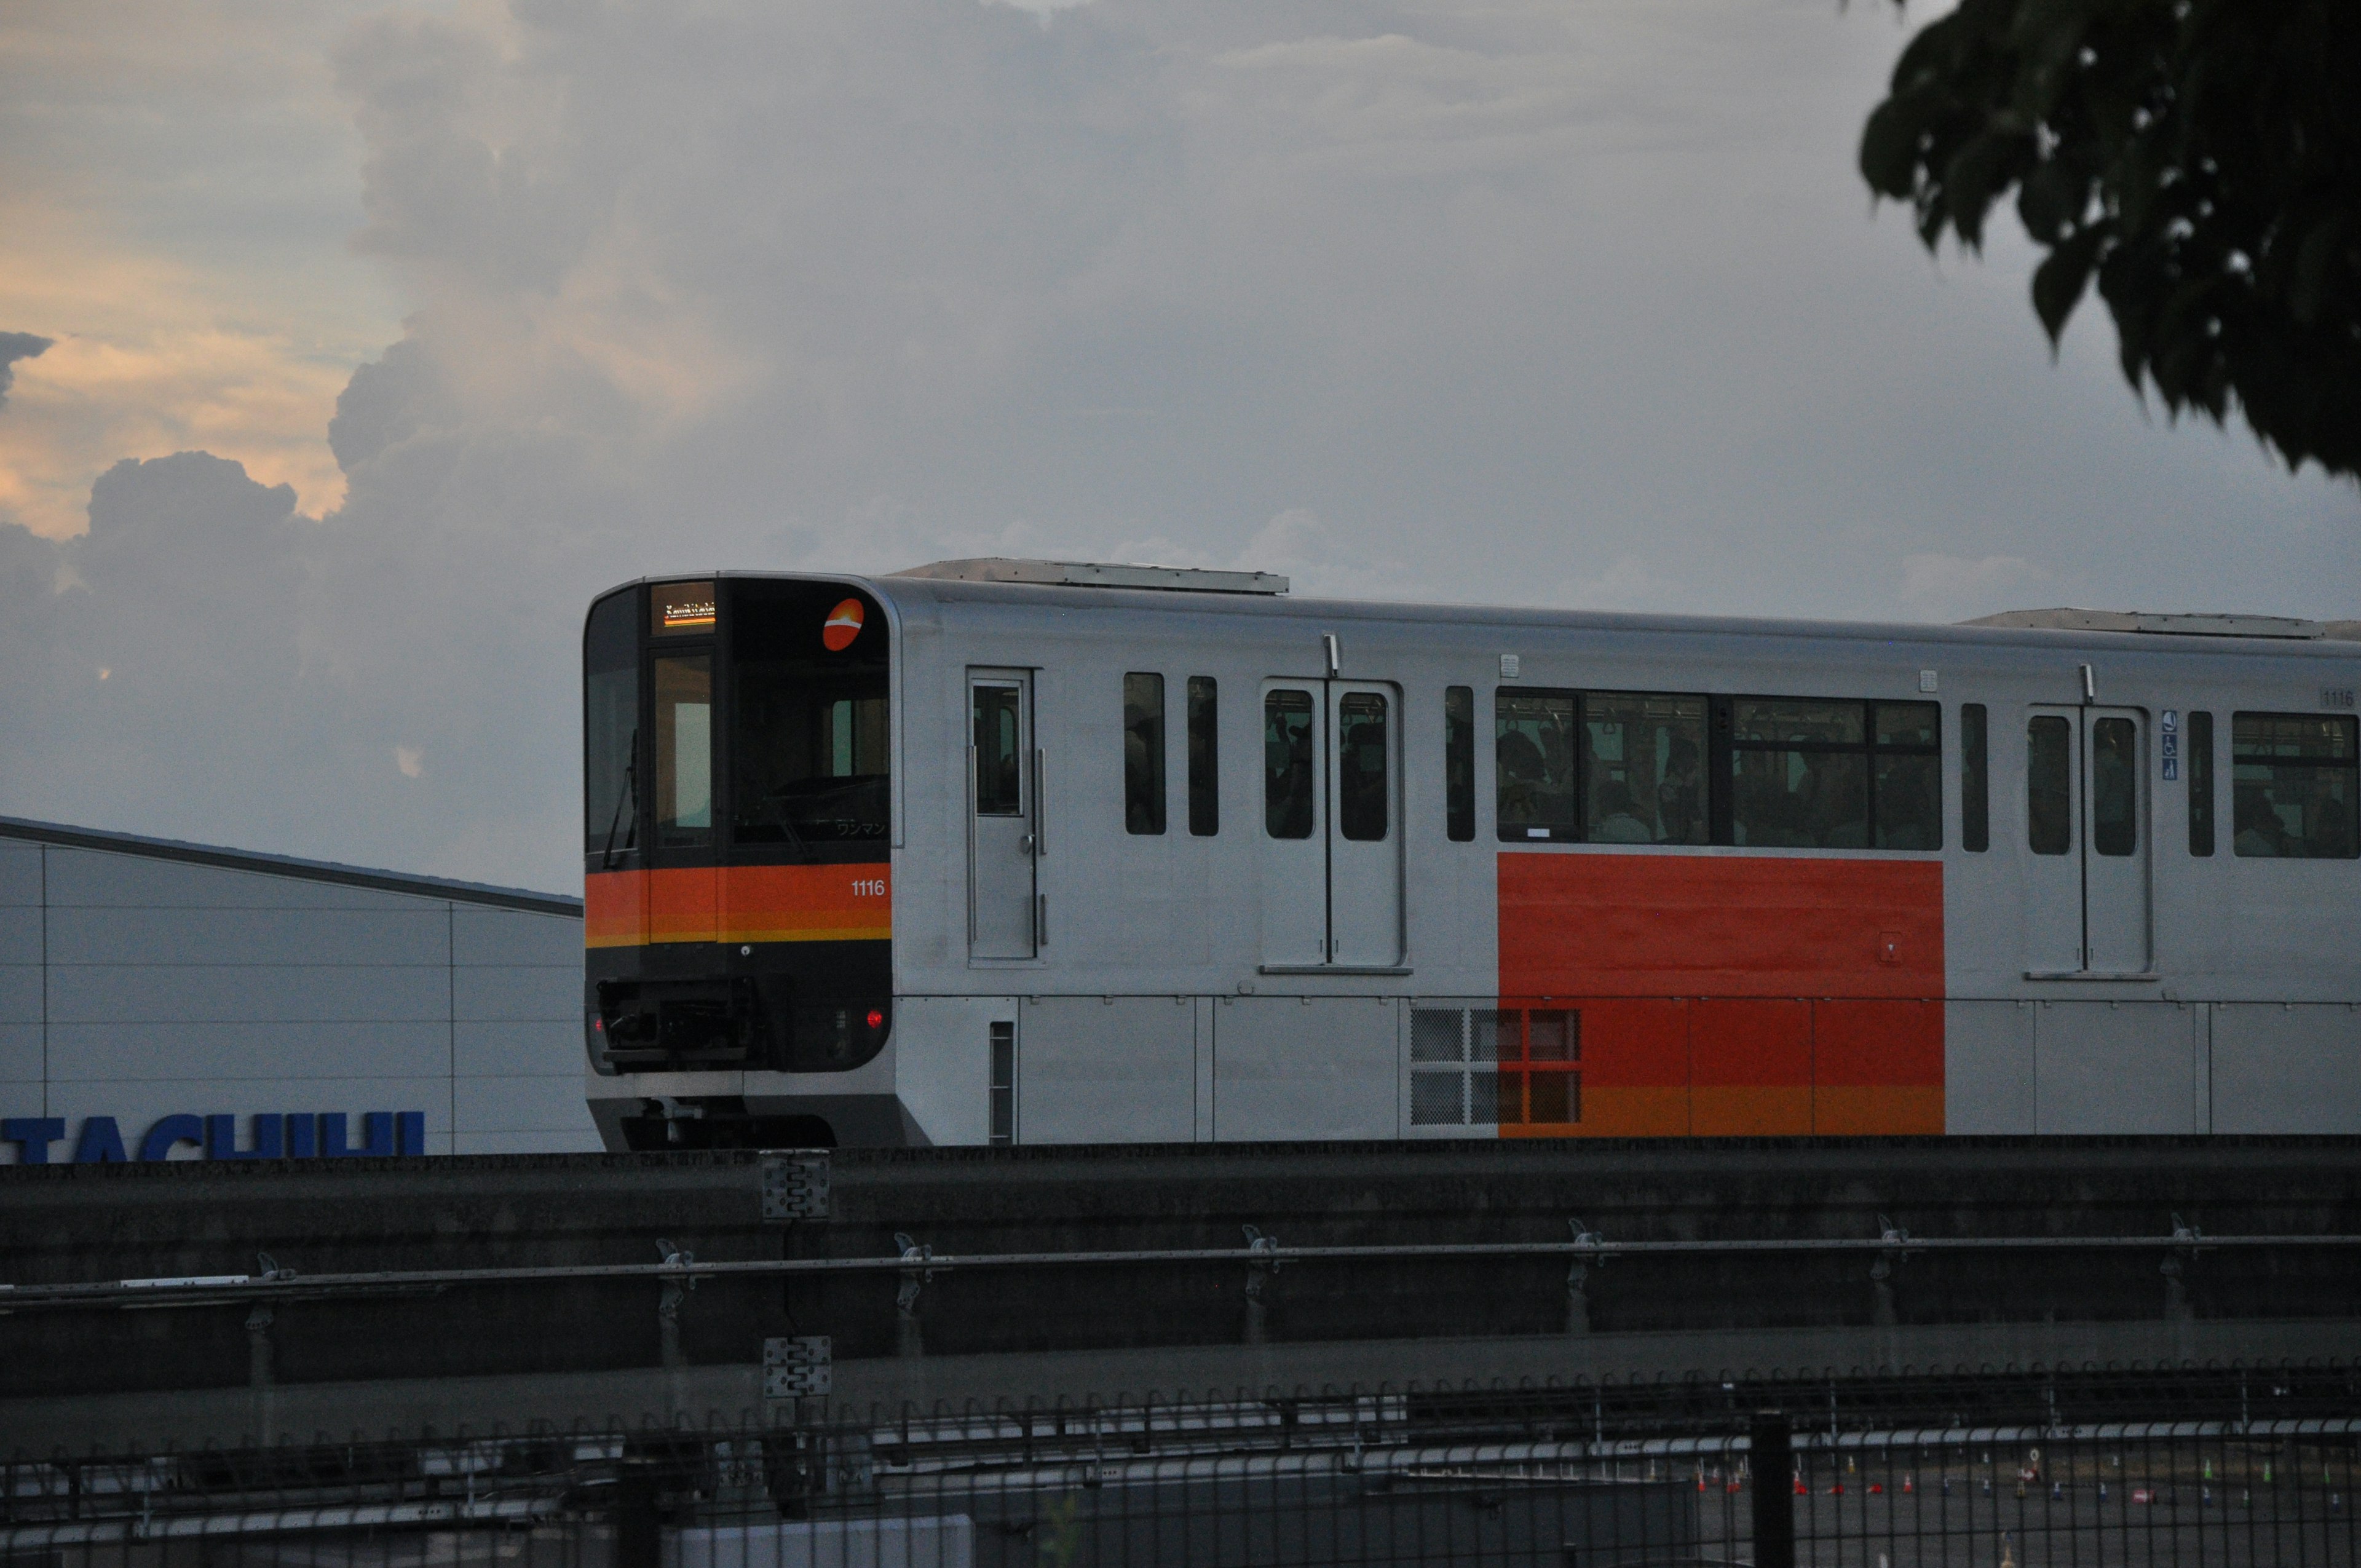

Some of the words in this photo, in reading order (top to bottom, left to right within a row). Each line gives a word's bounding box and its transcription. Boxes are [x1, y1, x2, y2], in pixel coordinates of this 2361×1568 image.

[2325, 691, 2354, 706] 1116
[837, 823, 885, 836] ワンマン
[852, 879, 885, 896] 1116
[1, 1111, 425, 1164] TACHIHI
